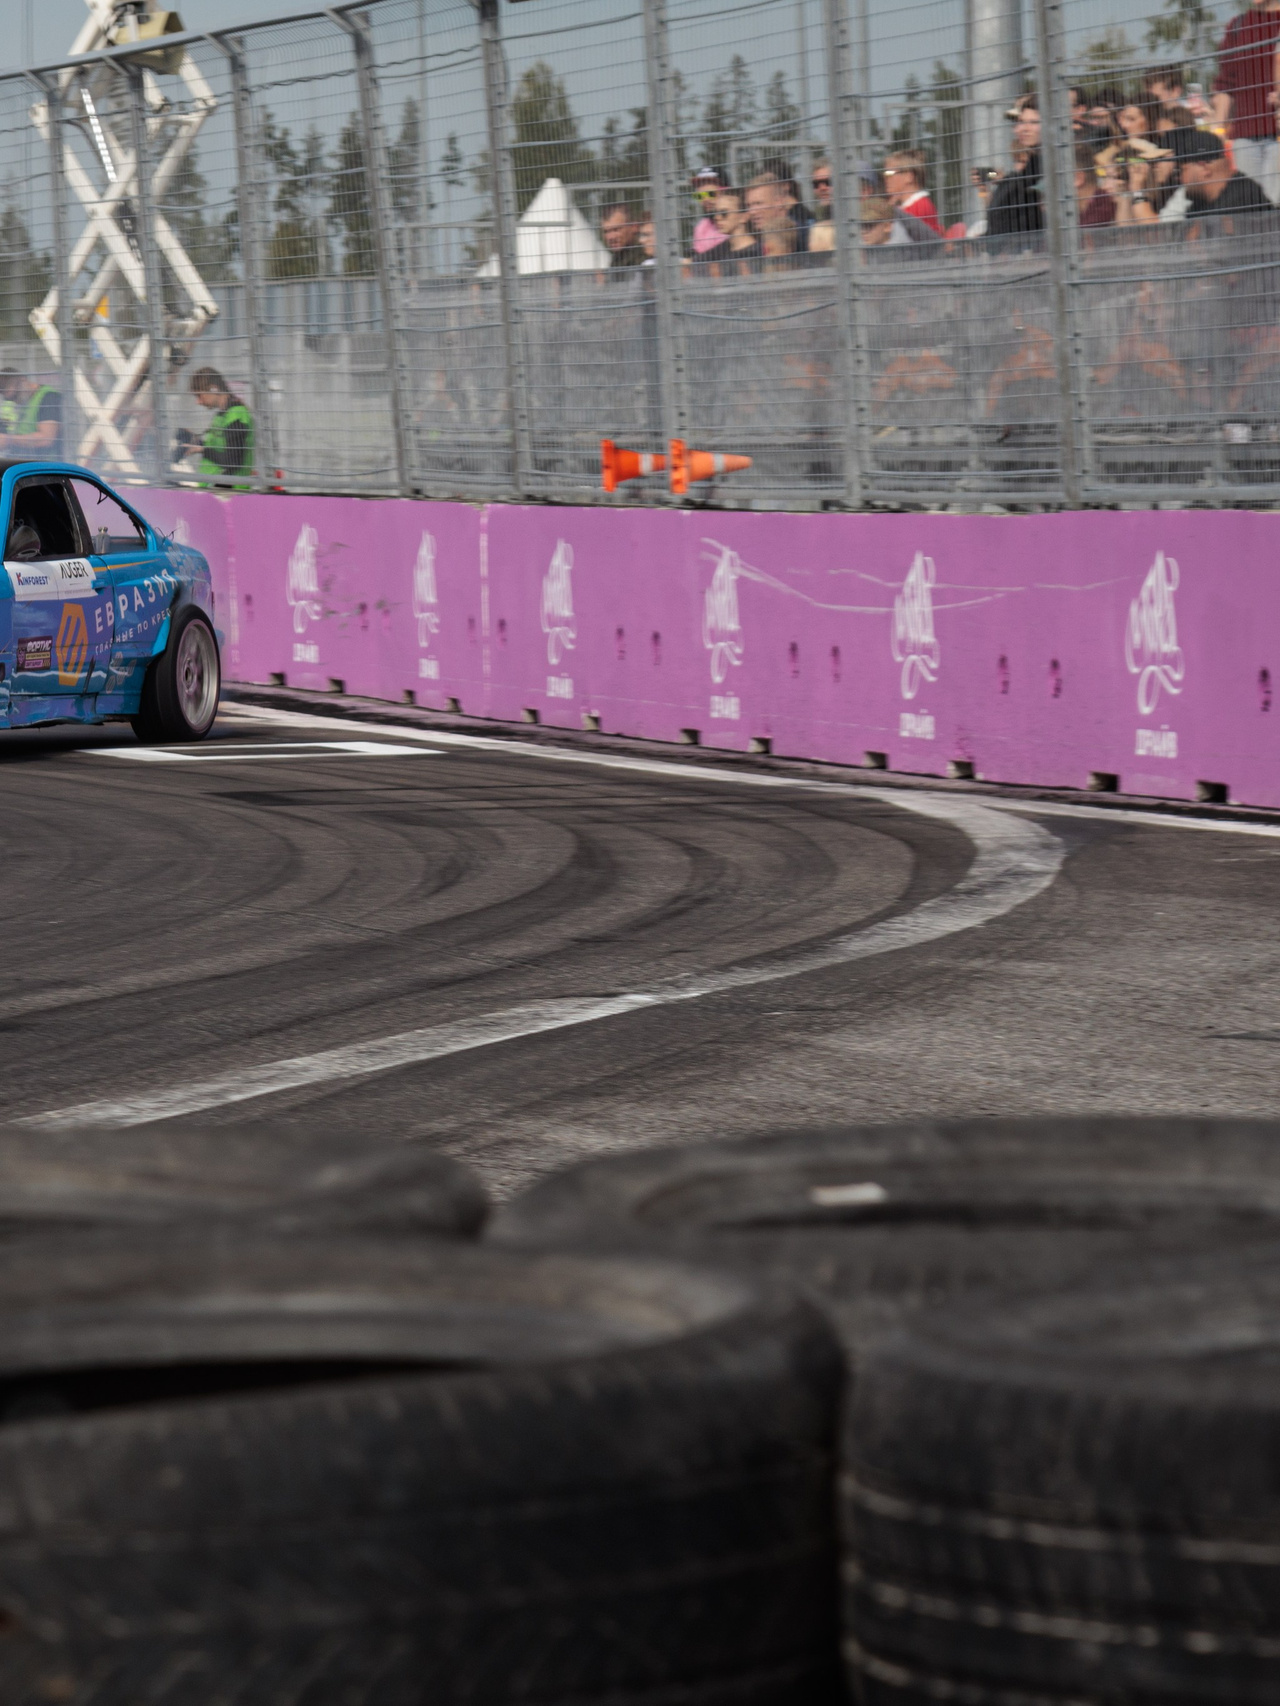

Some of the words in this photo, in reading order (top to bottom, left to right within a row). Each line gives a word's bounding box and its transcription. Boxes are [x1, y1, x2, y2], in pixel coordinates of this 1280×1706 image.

[15, 572, 49, 586] KINFOREST
[94, 568, 179, 634] ЕВРАЗИЯ
[137, 620, 149, 634] ПО
[26, 640, 52, 652] ФОРТИС
